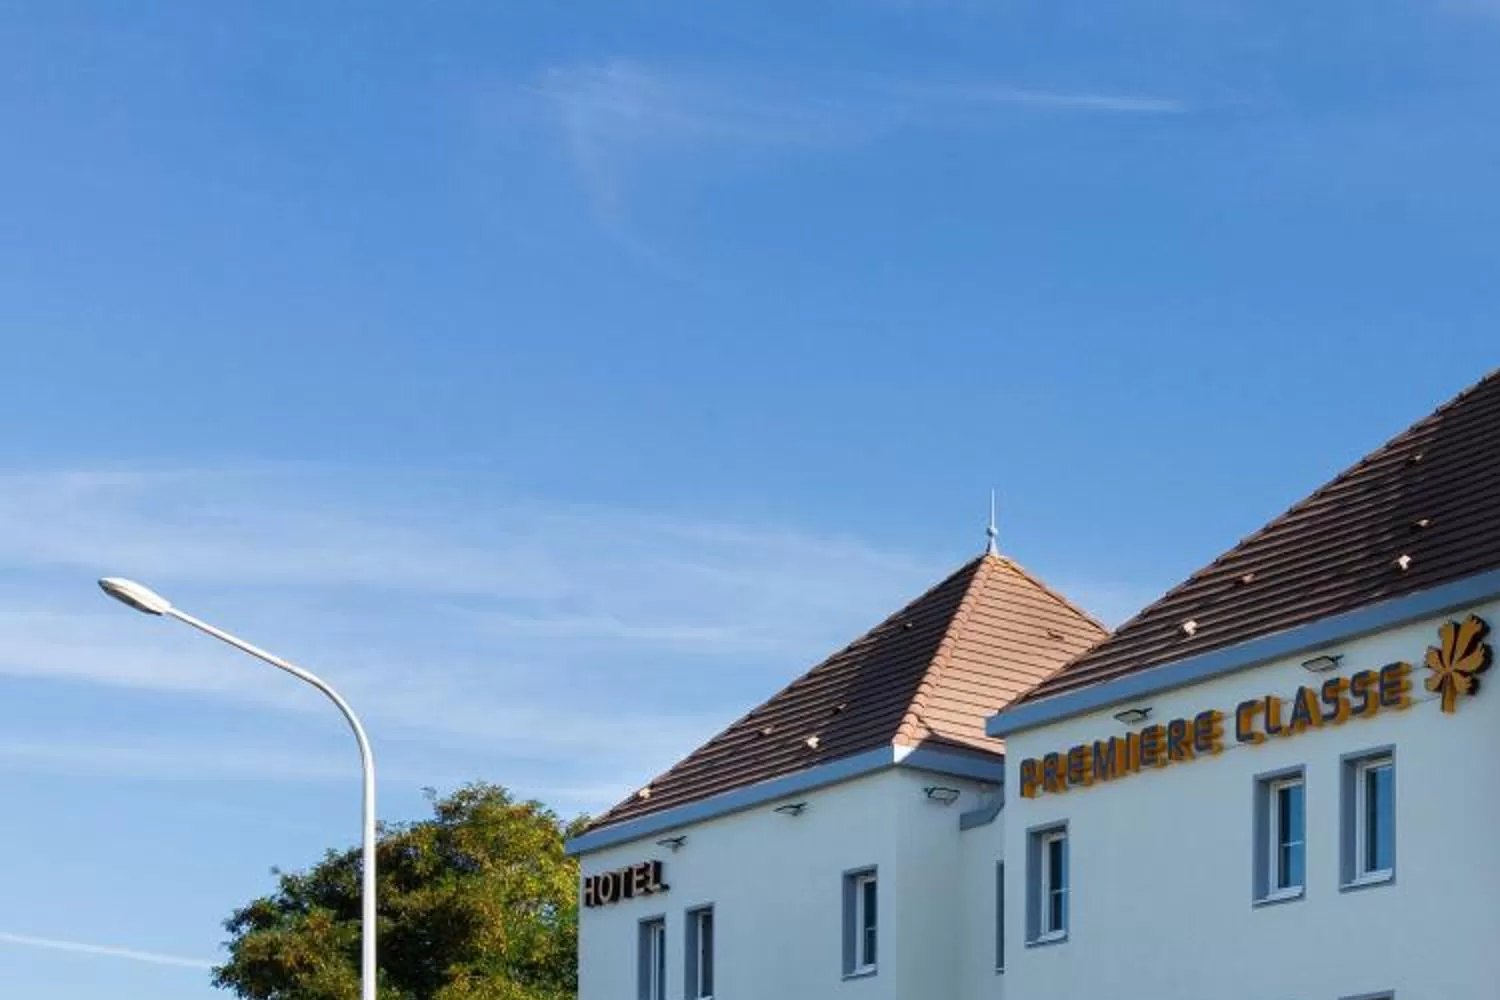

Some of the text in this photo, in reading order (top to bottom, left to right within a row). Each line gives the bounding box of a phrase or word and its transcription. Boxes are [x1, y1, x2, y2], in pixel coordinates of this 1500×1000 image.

[1019, 660, 1413, 799] PREMIERE CLASSE
[584, 861, 664, 907] HOTEL
